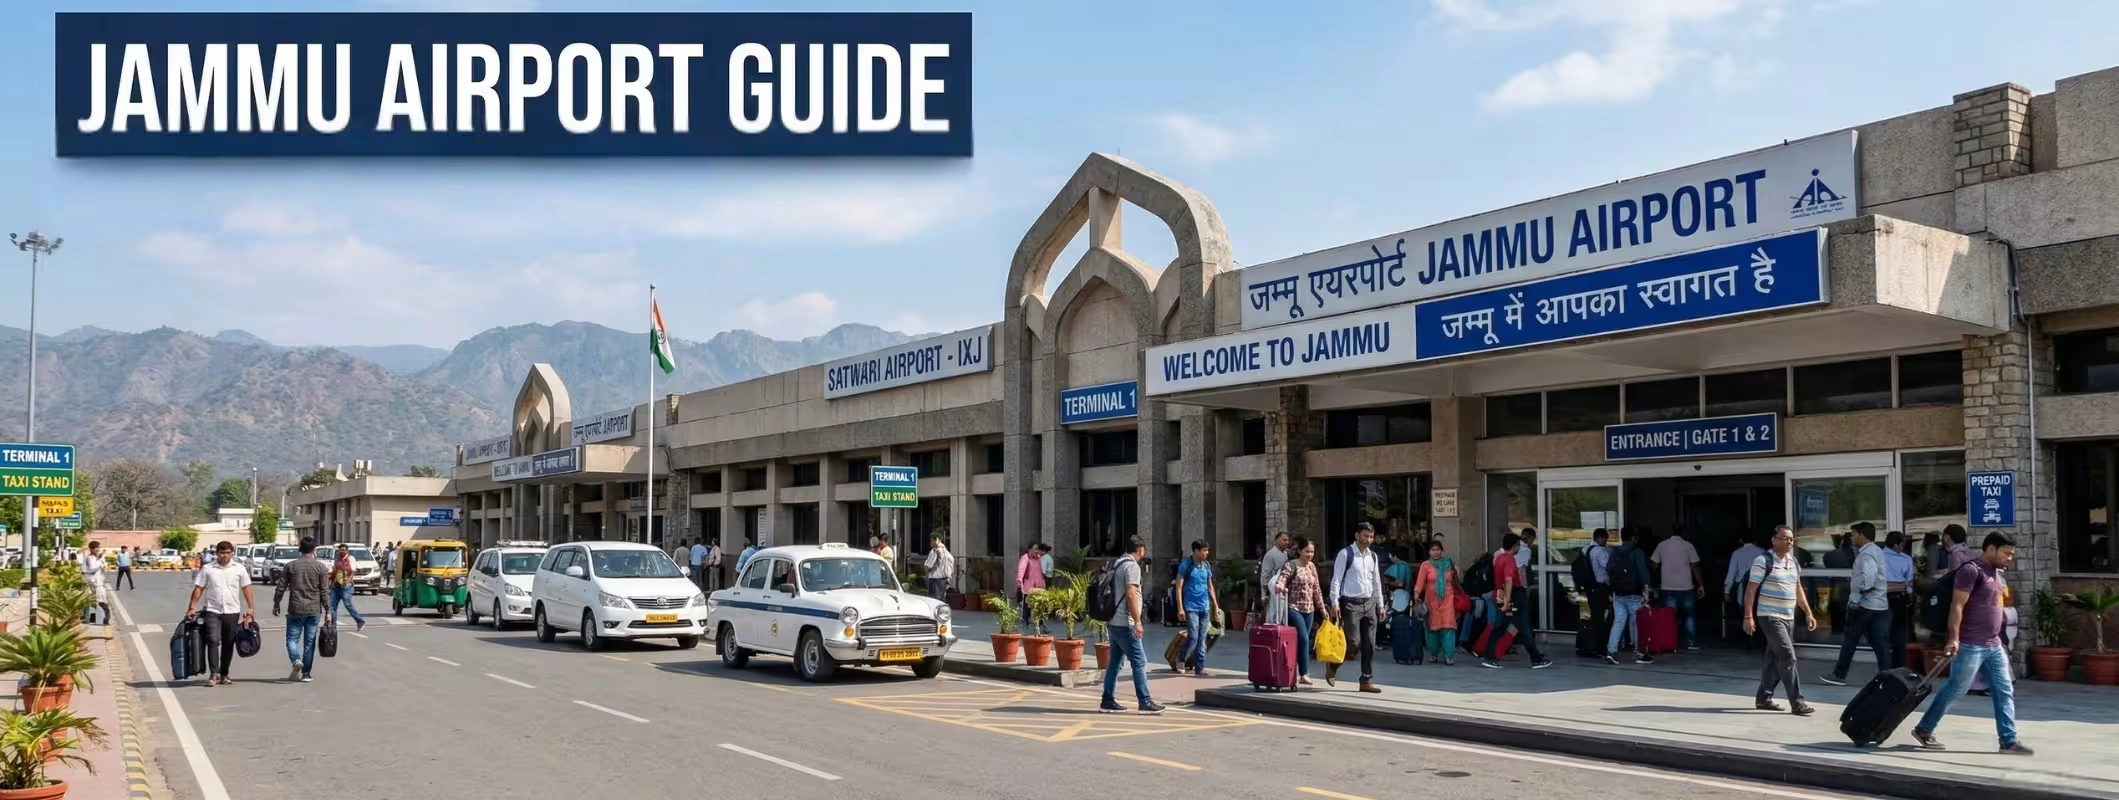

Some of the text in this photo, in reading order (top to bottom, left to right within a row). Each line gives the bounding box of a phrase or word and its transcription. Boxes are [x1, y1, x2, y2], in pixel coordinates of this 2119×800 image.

[1249, 169, 1766, 319] जम्मू एयरपोर्ट JAMMU AIRPORT
[1441, 247, 1776, 344] जम्मू में आपका स्वागत है
[1163, 321, 1390, 382] WELCOME TO JAMMU
[828, 358, 881, 392] SATWARI
[885, 345, 942, 380] AIRPORT
[958, 336, 982, 367] IXJ
[1065, 389, 1136, 416] TERMINAL 1
[1611, 431, 1680, 450] ENTRANCE
[1692, 428, 1727, 445] GATE
[1732, 427, 1739, 442] 1
[1745, 425, 1756, 442] &
[1760, 425, 1770, 441] 2
[2, 450, 70, 463] TERMINAL 1
[2, 475, 70, 488] TAXI STAND
[875, 472, 915, 482] TERMINAL 1
[1971, 475, 2011, 486] PREPAID
[875, 492, 916, 502] TAXI STAND
[1981, 486, 2002, 496] TAXI
